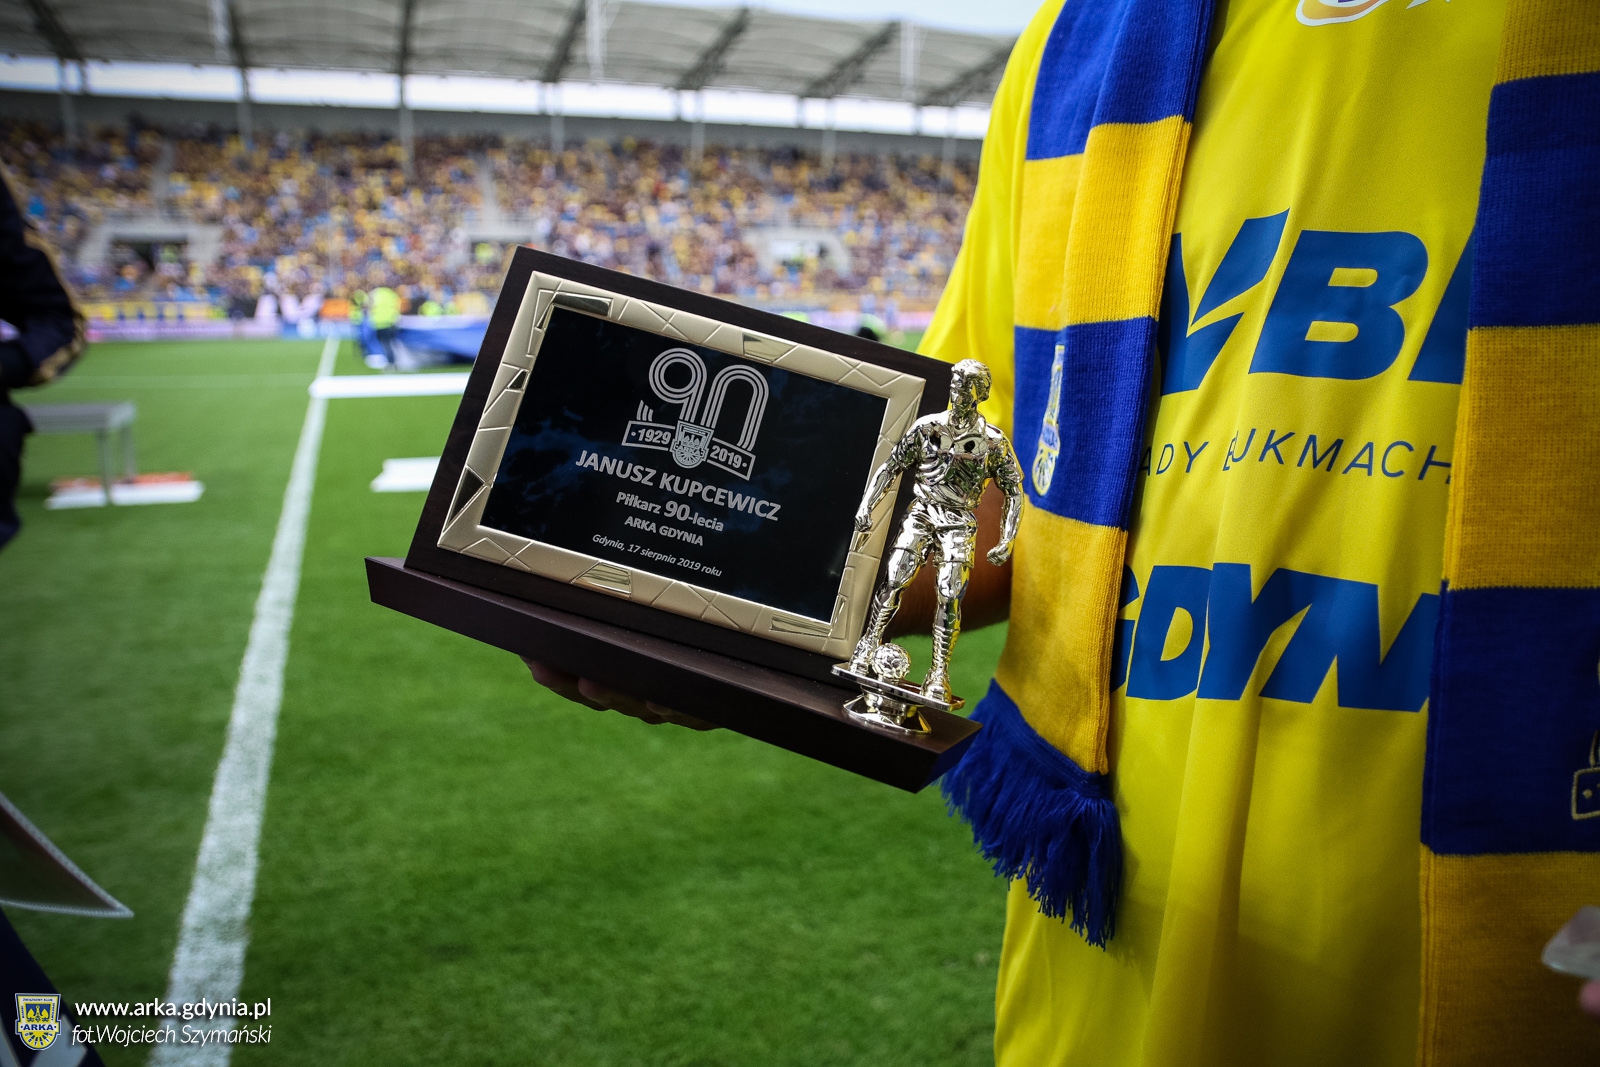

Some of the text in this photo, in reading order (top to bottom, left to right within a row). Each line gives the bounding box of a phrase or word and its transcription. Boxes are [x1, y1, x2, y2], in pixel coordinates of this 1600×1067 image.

[636, 347, 770, 452] 90
[638, 429, 672, 445] 1929
[709, 445, 742, 469] 2019
[575, 450, 781, 521] JANUSZ KUPCEWICZ
[616, 492, 724, 532] Piłkarz 90-lecia
[624, 516, 704, 546] ARKA GDYNIA
[592, 534, 723, 577] Gdynia, 17 sierpnia 2019 roku
